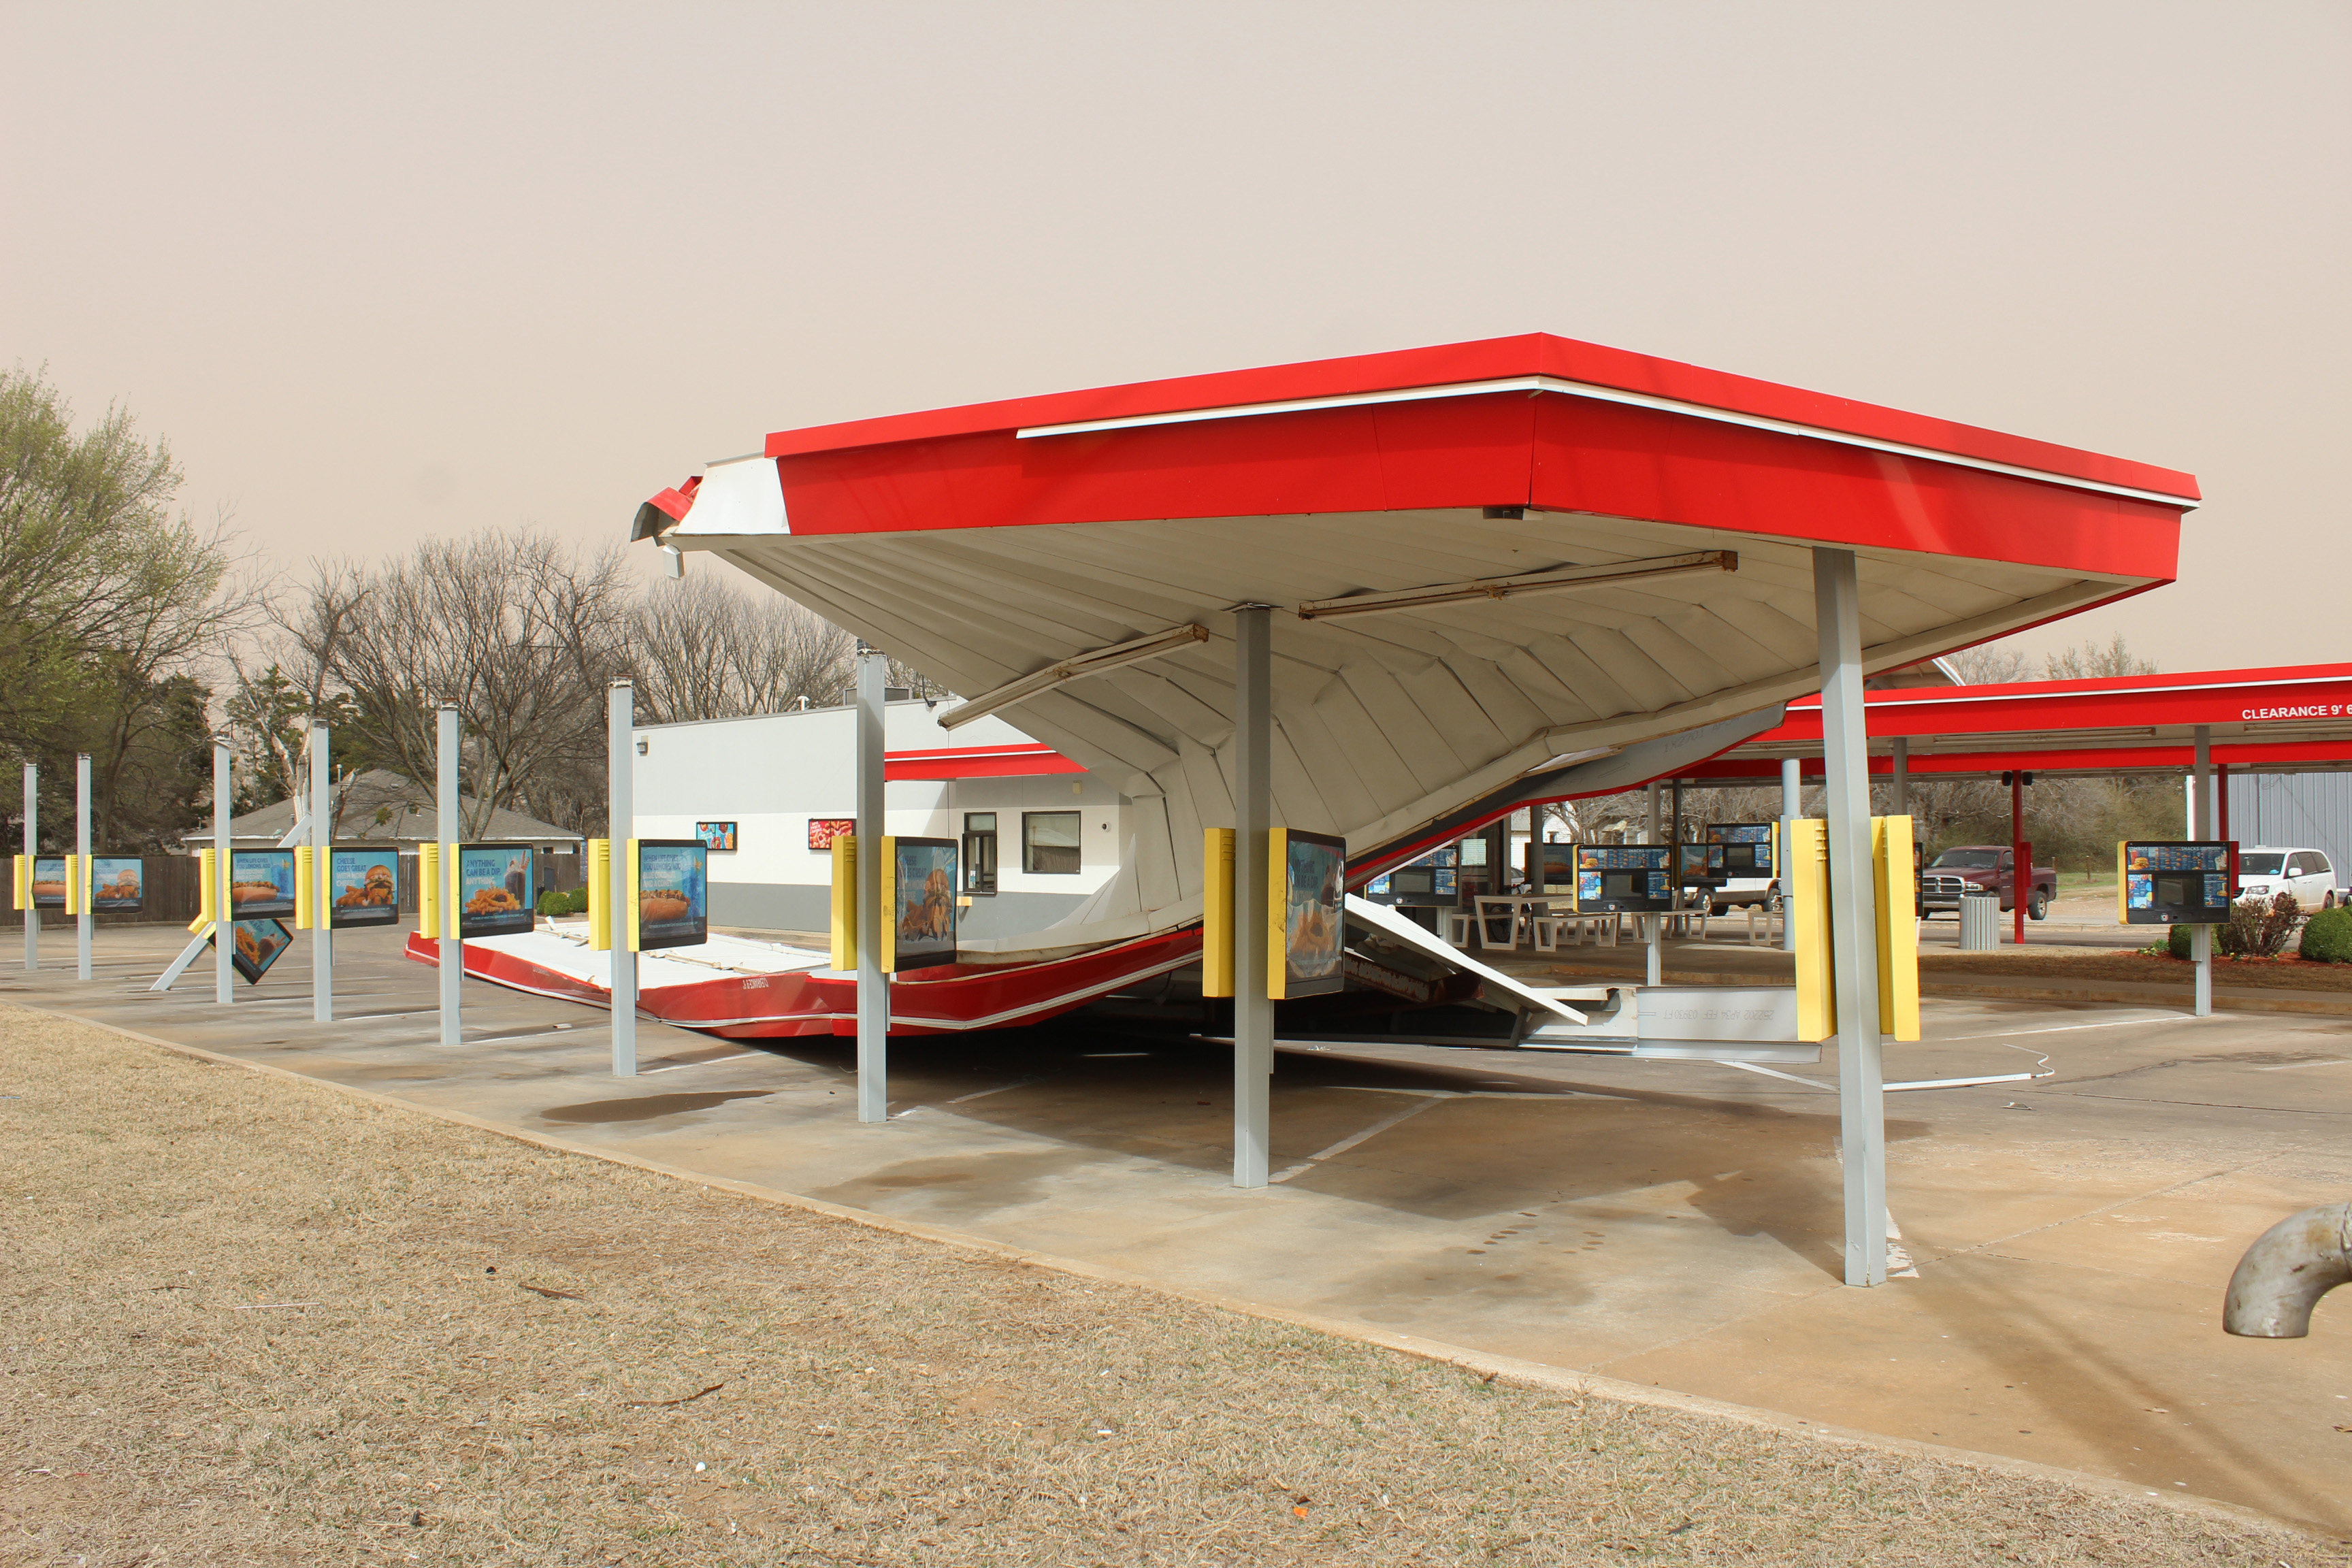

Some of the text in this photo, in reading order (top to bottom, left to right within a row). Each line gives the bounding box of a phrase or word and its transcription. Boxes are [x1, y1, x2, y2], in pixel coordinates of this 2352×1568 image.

[2242, 705, 2328, 720] CLEARANCE
[2330, 704, 2342, 715] 9'
[466, 860, 495, 868] ANYTHING
[643, 863, 653, 871] YOU
[466, 868, 478, 877] CAN
[485, 868, 491, 876] A
[491, 868, 502, 876] DIP.
